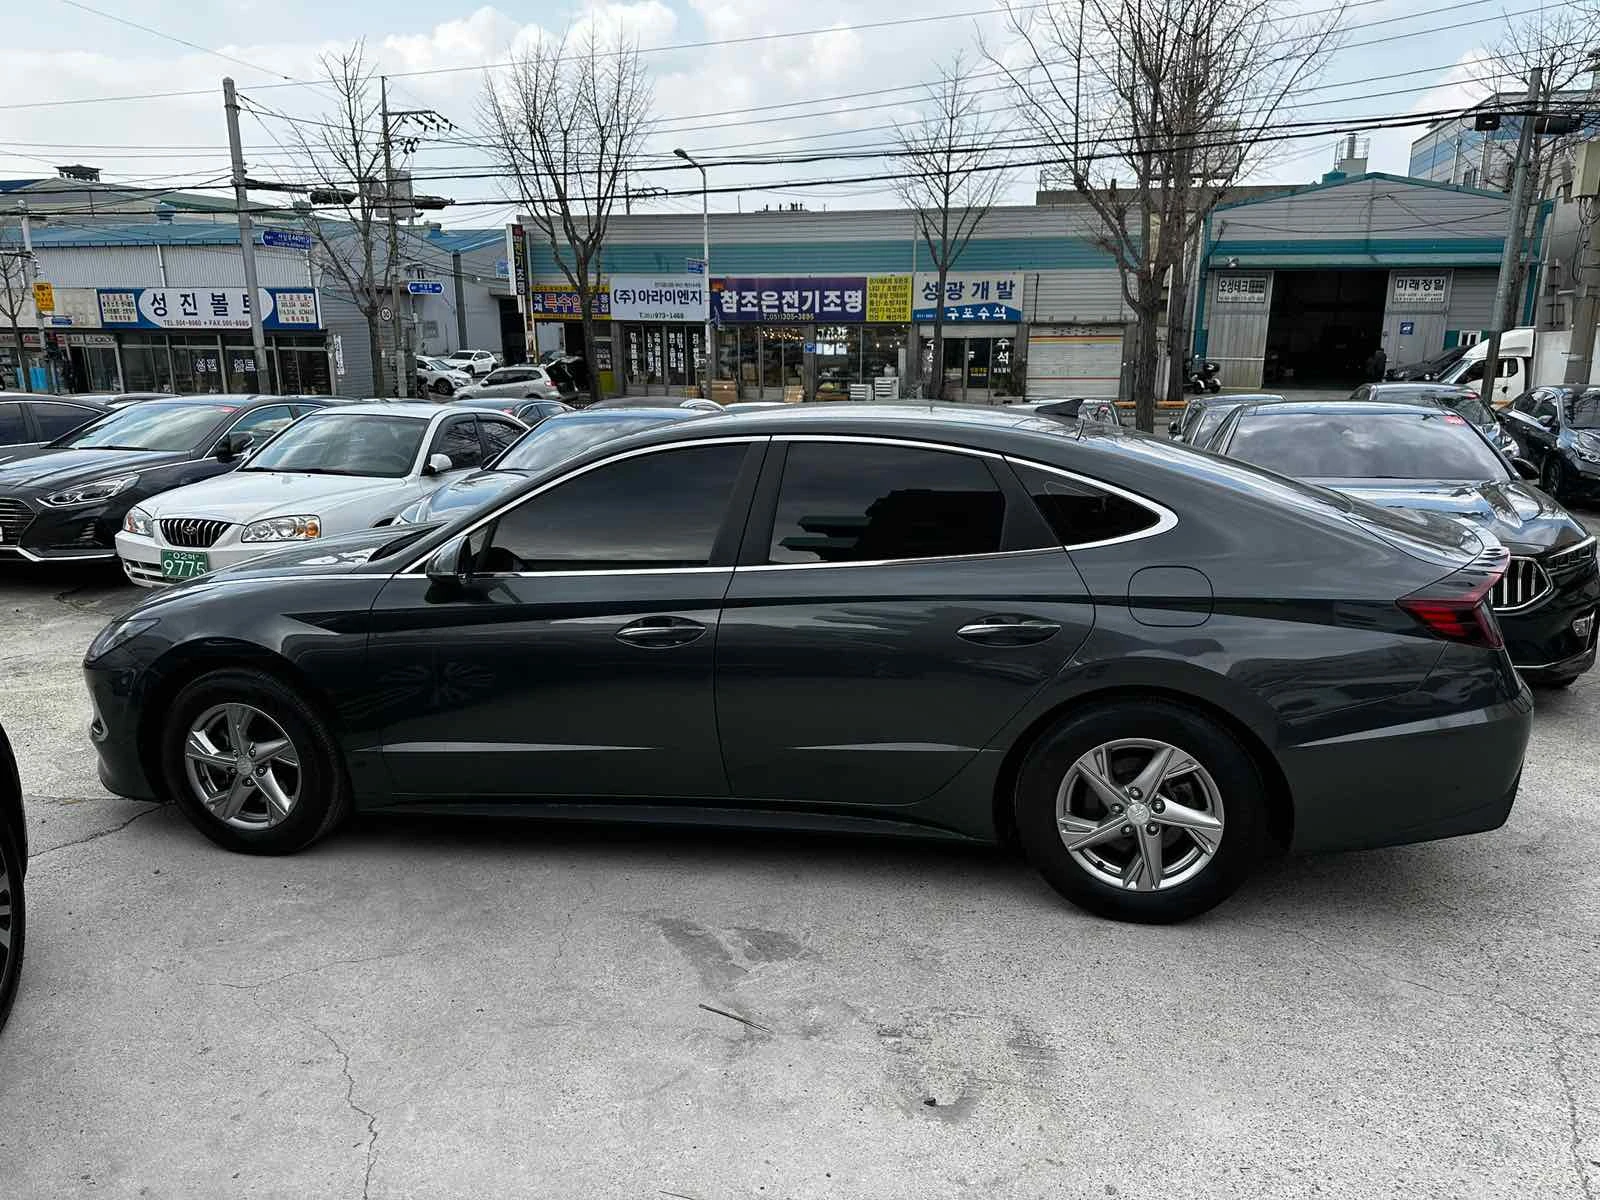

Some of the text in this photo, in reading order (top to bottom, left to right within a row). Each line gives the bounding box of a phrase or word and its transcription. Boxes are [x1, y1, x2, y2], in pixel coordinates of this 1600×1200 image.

[922, 280, 1016, 301] 성광개발
[720, 290, 863, 313] 참조은전기조명
[947, 306, 1007, 320] 구포수석
[997, 338, 1010, 364] 수석
[164, 560, 206, 577] 9775
